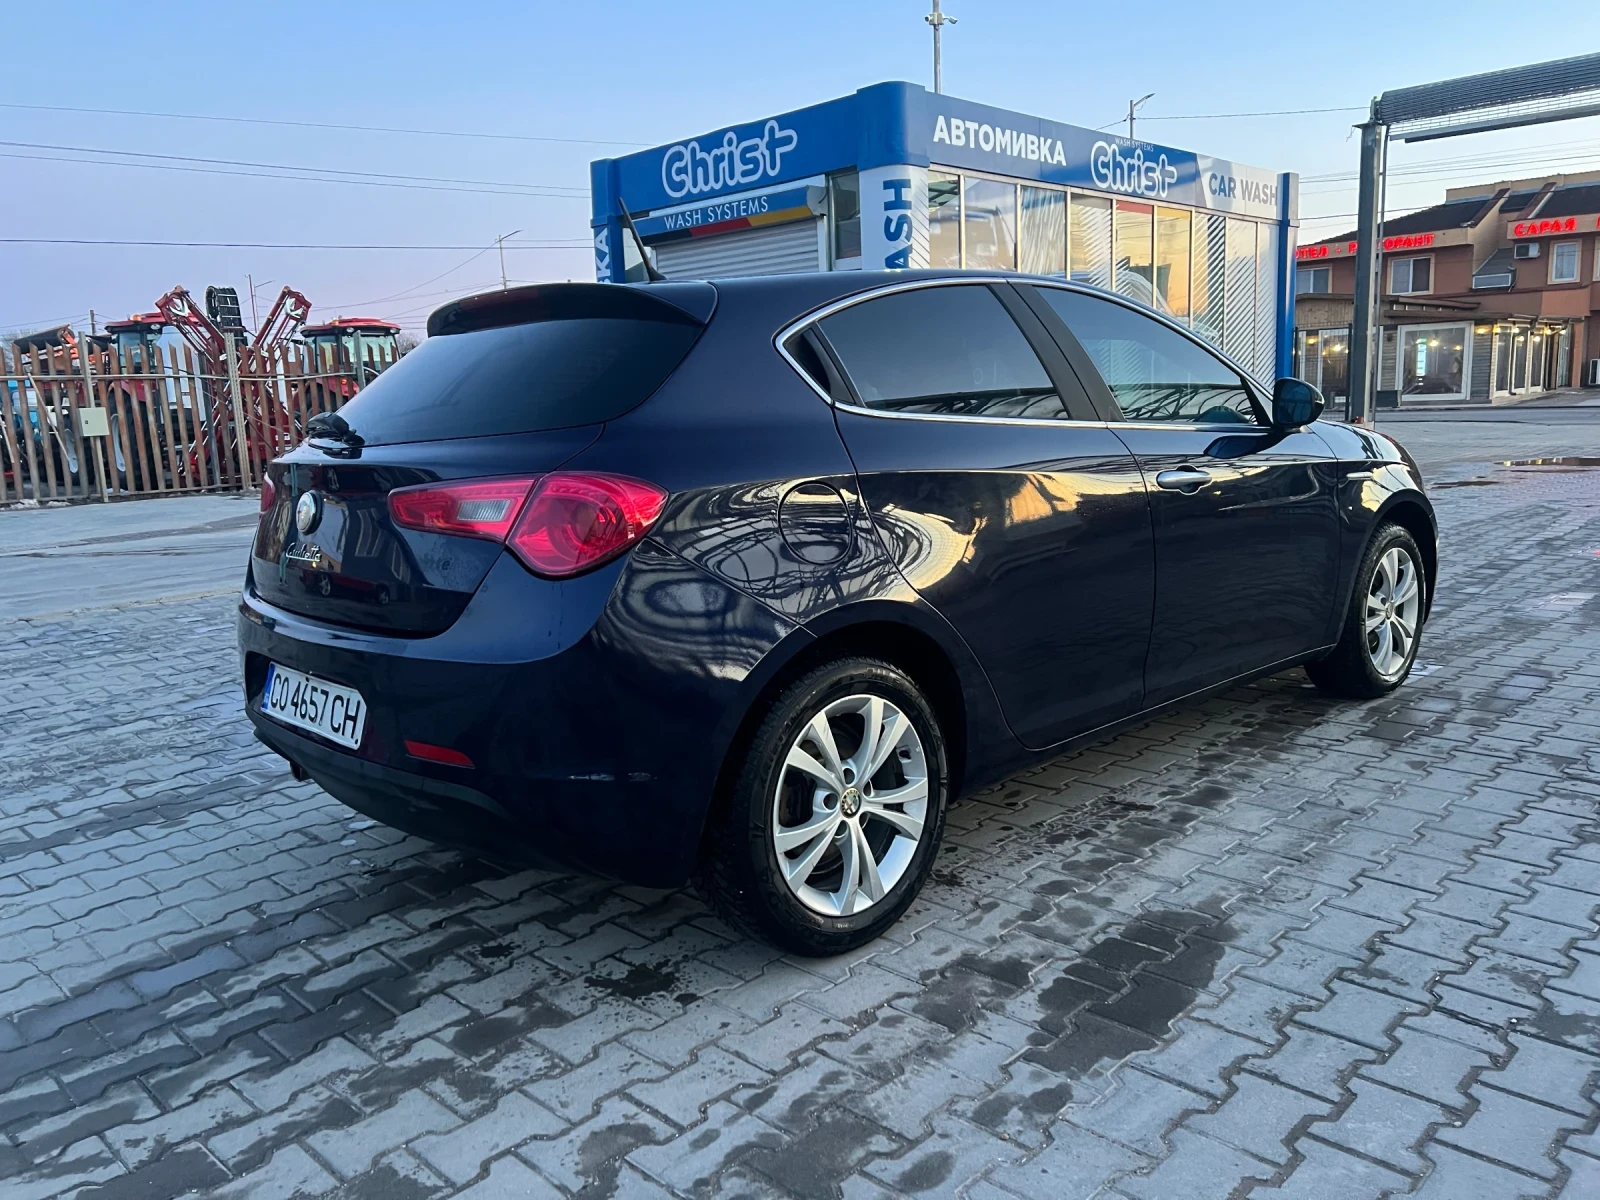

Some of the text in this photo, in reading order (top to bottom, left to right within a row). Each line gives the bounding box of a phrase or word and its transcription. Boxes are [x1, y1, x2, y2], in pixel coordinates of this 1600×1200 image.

[662, 120, 798, 198] Christ
[932, 115, 1067, 166] АВТОМИВКА
[1115, 137, 1154, 152] WASH SYSTEMS
[1091, 141, 1178, 198] Christ
[1208, 173, 1278, 206] CAR WASH
[664, 196, 769, 230] WASH SYSTEMS
[883, 179, 913, 269] ASH
[1514, 217, 1577, 237] САРАЯ
[291, 680, 330, 727] 4657
